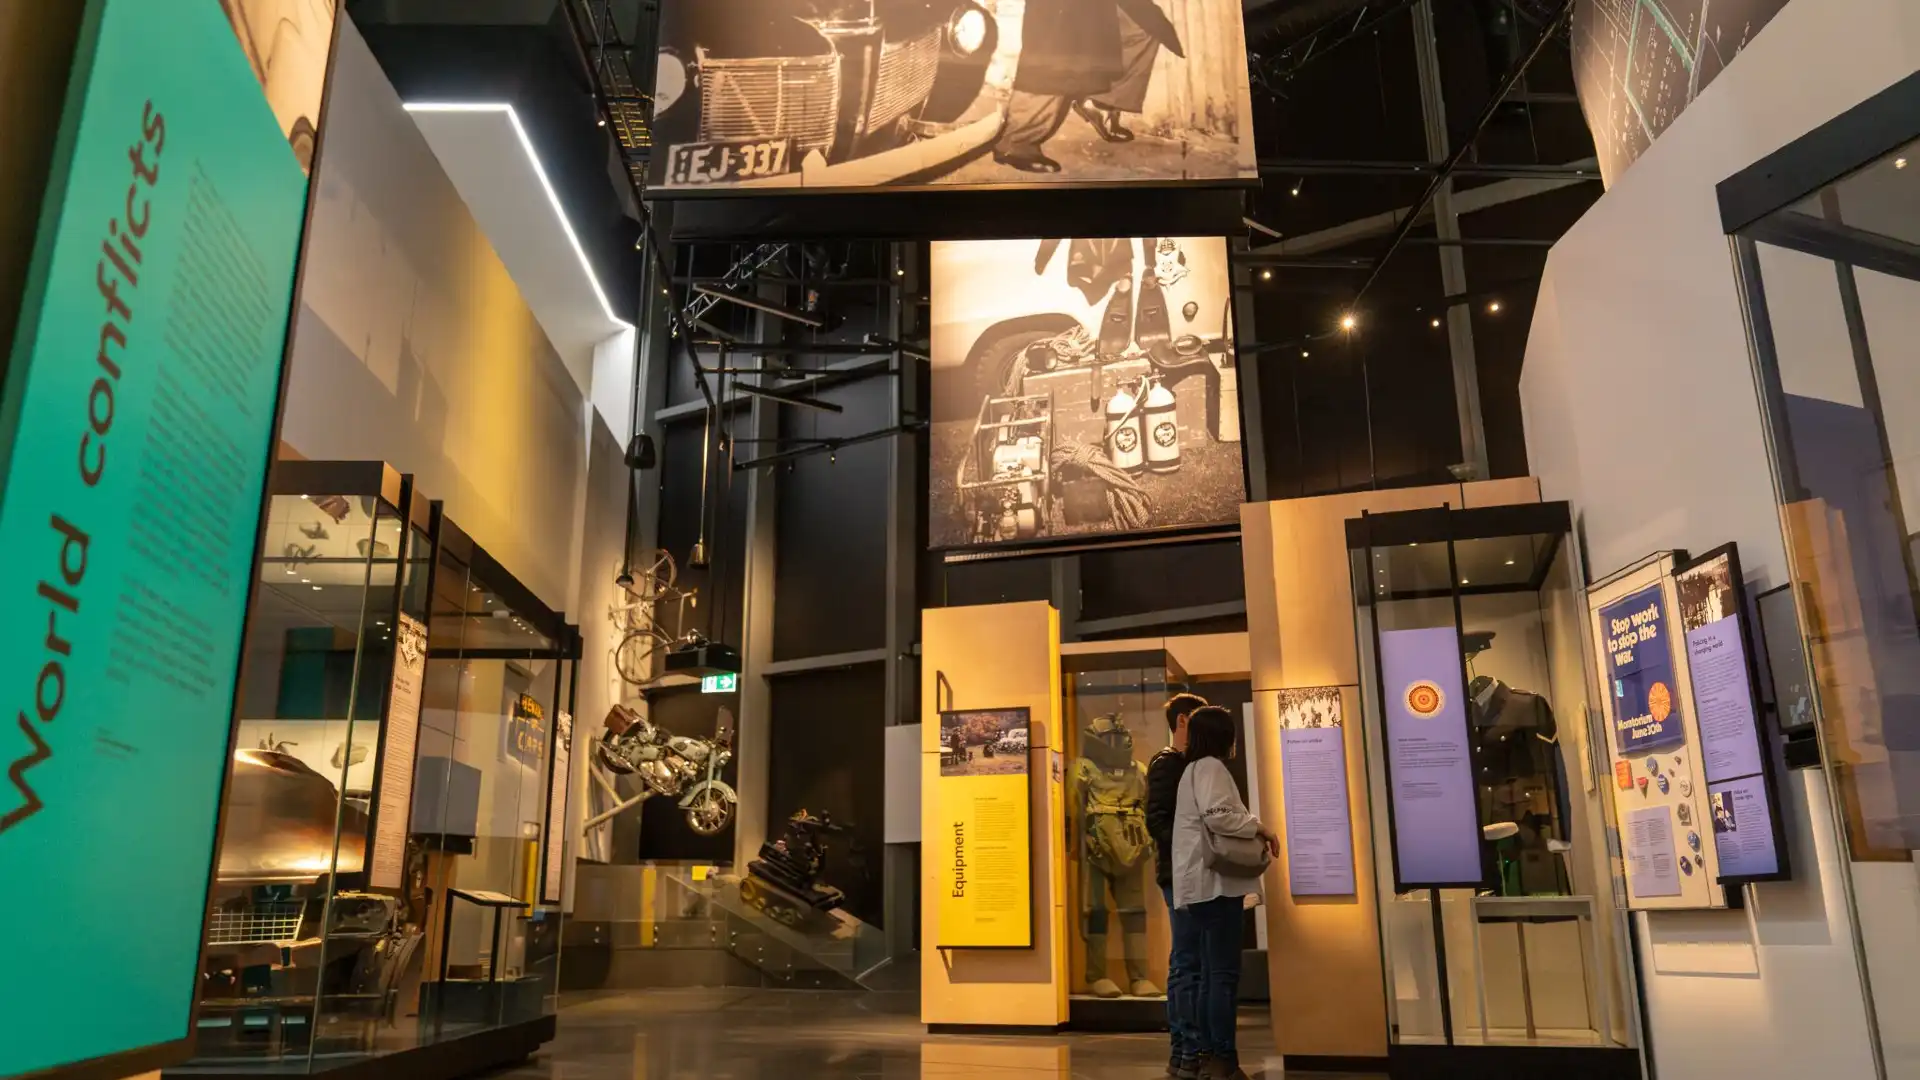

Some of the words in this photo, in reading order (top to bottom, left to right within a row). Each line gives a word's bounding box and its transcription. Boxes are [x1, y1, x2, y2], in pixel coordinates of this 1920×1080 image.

[0, 512, 92, 836] World
[78, 98, 166, 488] conflicts
[1611, 617, 1631, 636] Stop
[1630, 603, 1659, 627] work
[1607, 637, 1618, 653] to
[1618, 631, 1638, 650] stop
[1638, 623, 1657, 642] the
[1615, 649, 1634, 667] war.
[1617, 713, 1653, 731] Moratorium
[1632, 727, 1648, 740] June
[1647, 722, 1663, 736] 30th
[952, 821, 968, 898] Equipment
